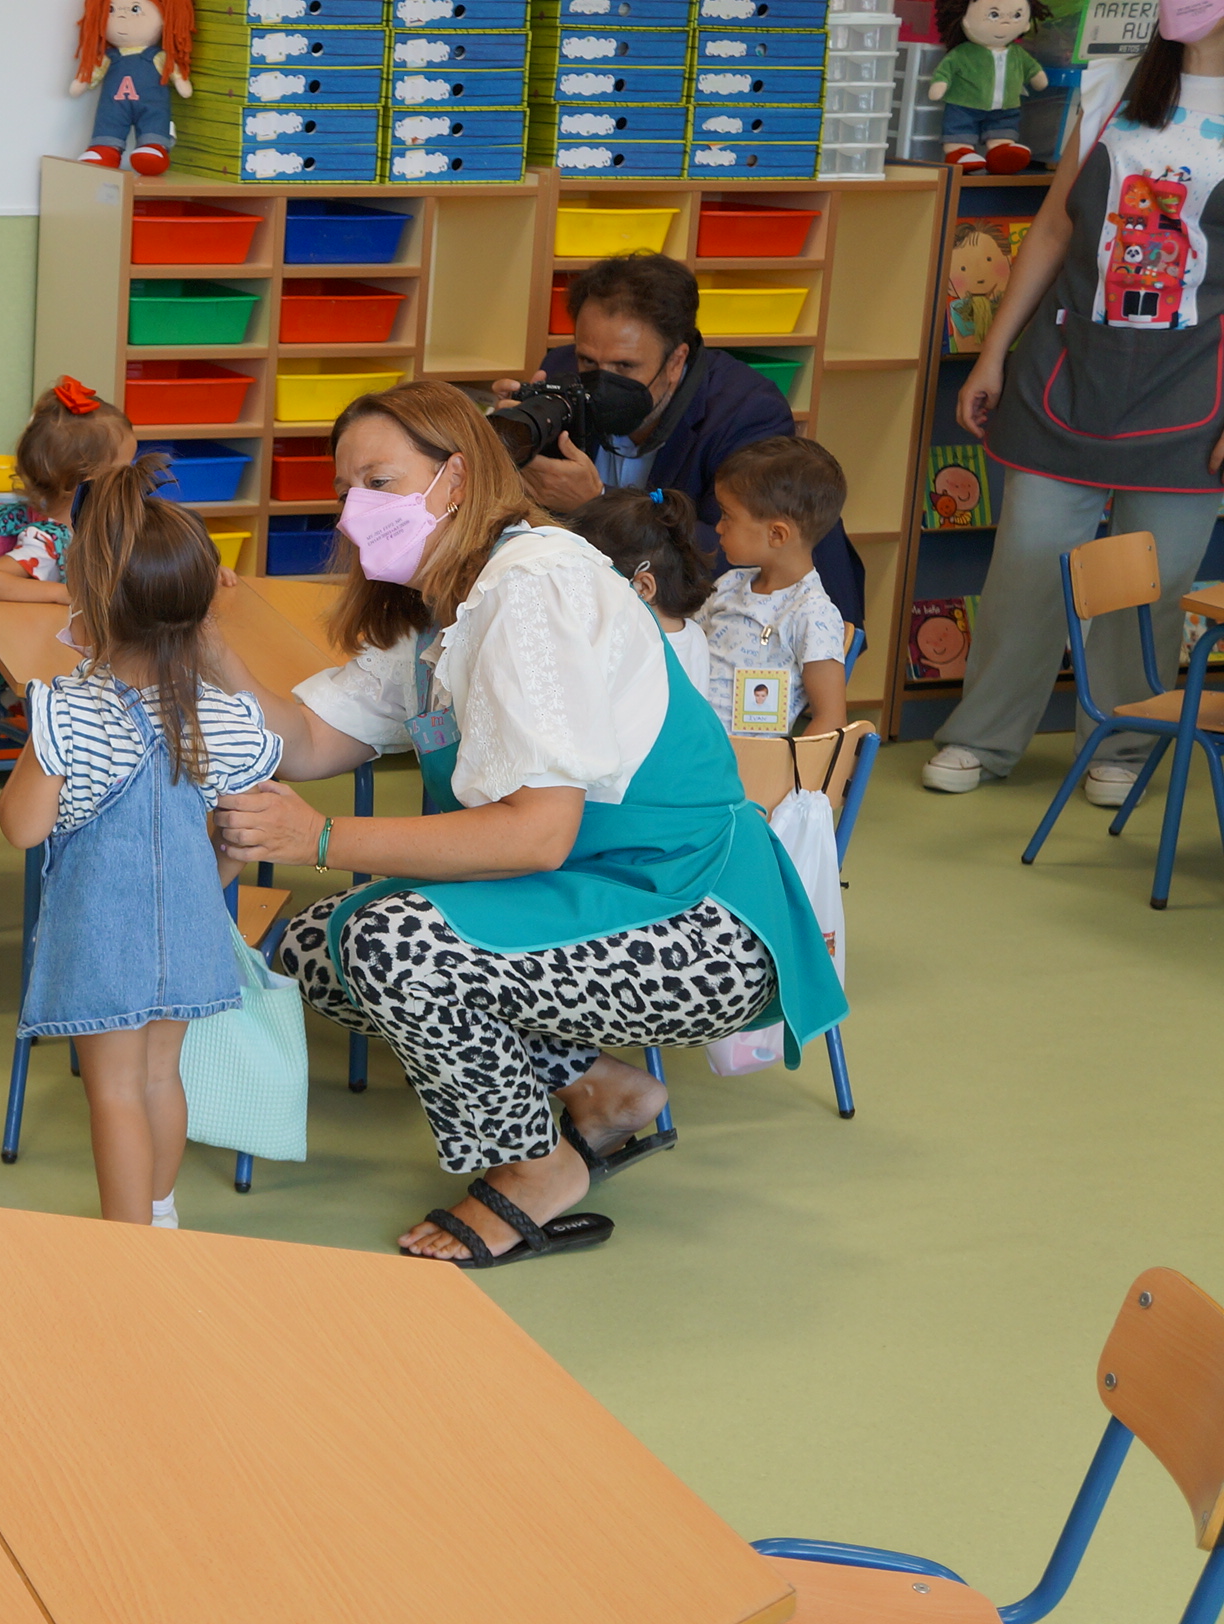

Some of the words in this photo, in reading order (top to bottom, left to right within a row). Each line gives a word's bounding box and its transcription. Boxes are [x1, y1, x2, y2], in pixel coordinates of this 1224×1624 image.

[1122, 22, 1153, 40] AU
[114, 76, 140, 101] A
[553, 1219, 590, 1232] MNG
